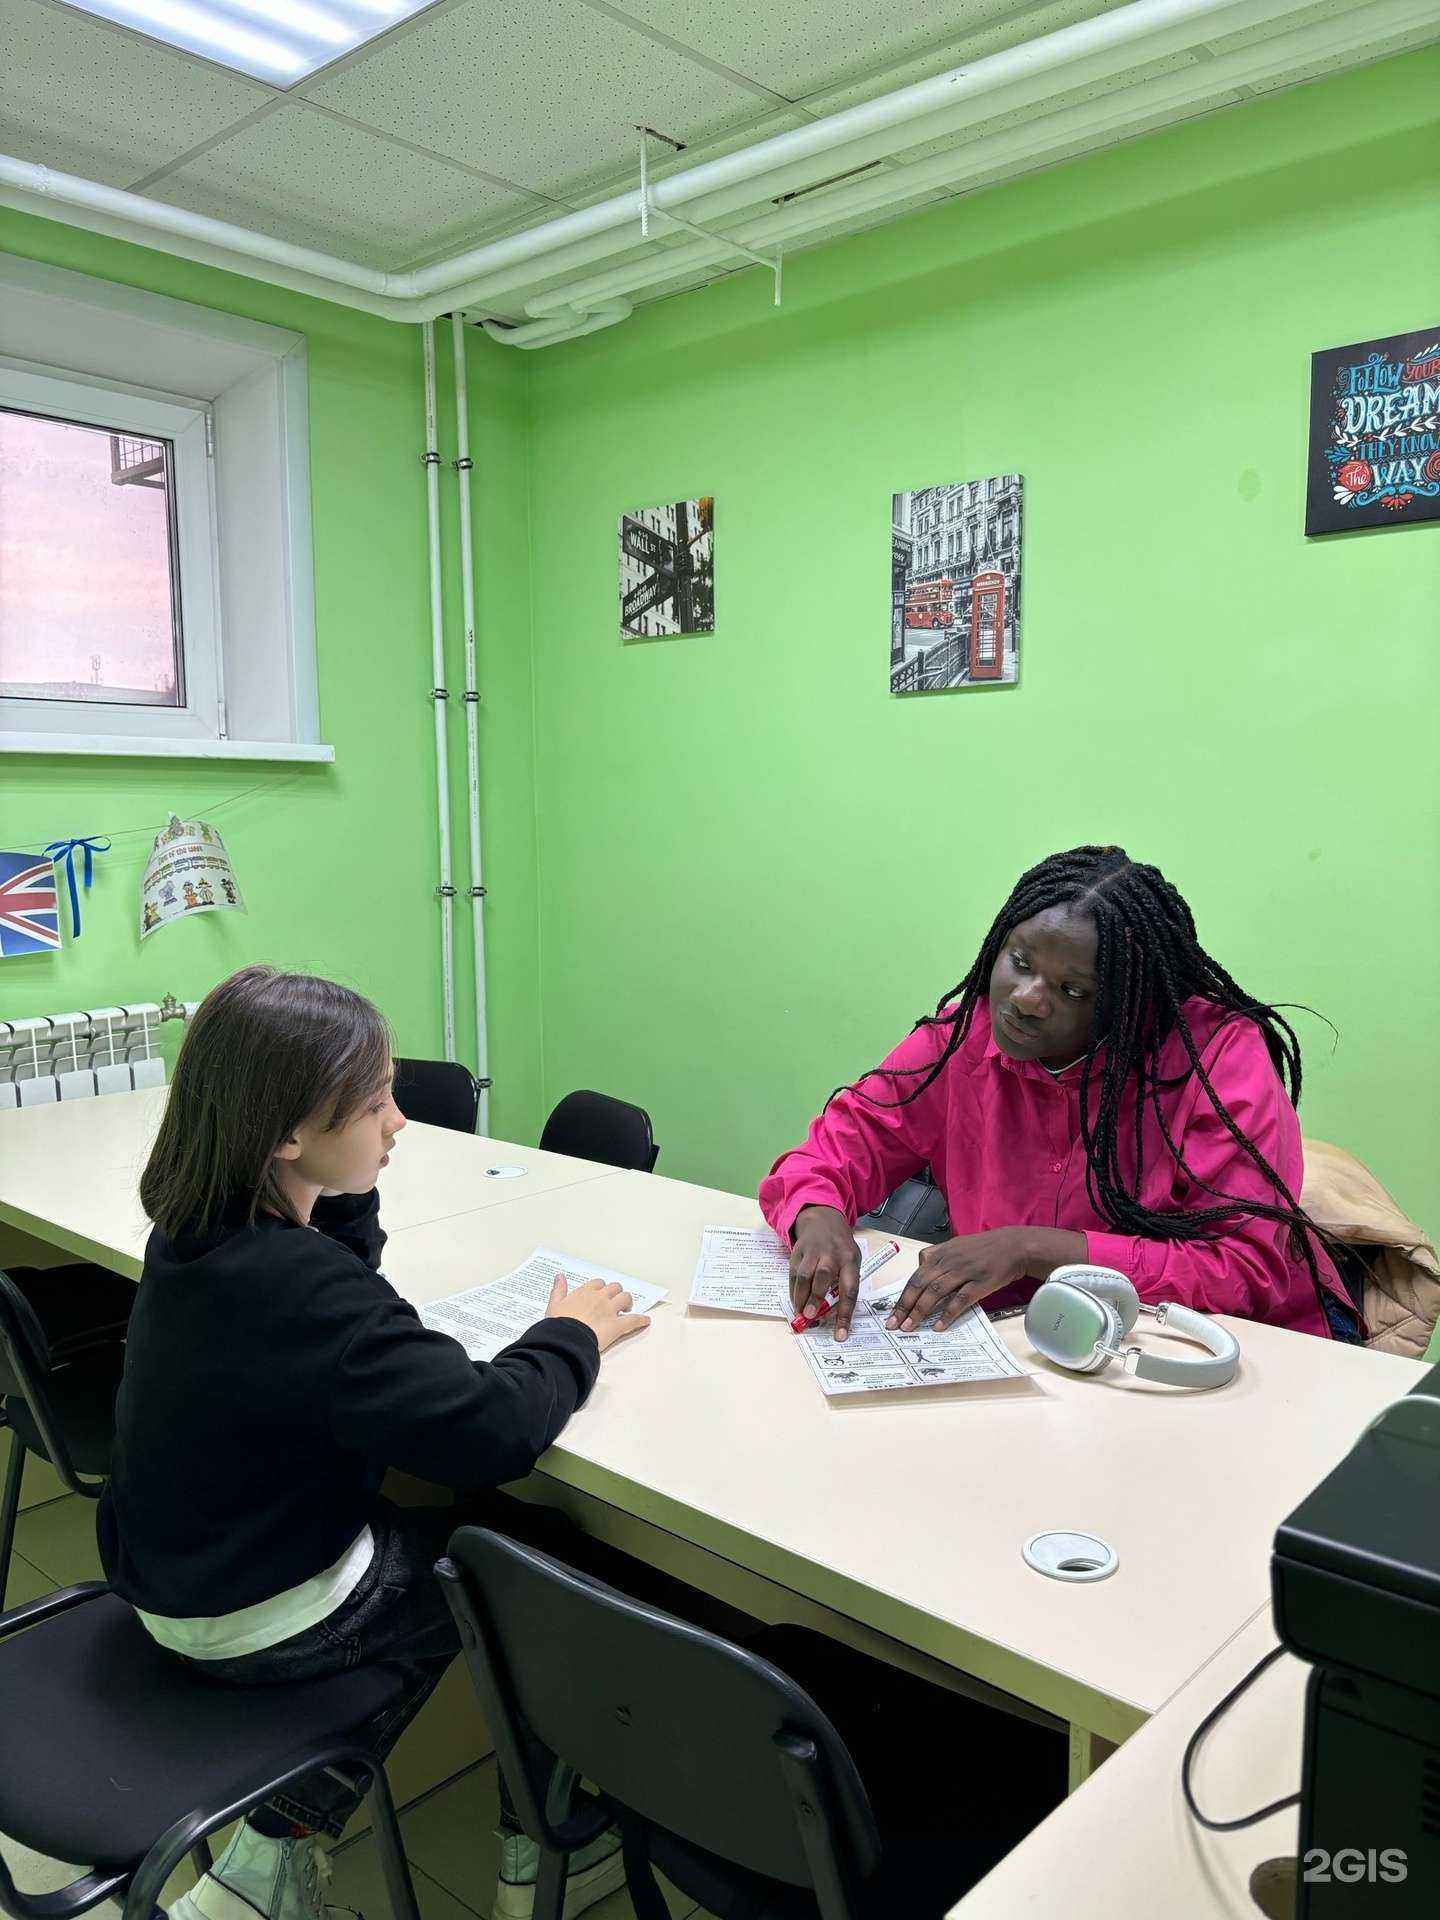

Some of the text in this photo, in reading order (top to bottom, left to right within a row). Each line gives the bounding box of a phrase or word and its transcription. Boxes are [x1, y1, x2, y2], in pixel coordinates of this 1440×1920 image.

[1347, 356, 1404, 395] FOLLOW
[1358, 439, 1396, 460] THEY
[1346, 456, 1429, 487] The WAY
[630, 531, 650, 554] WALL
[624, 583, 657, 617] BROADWAY
